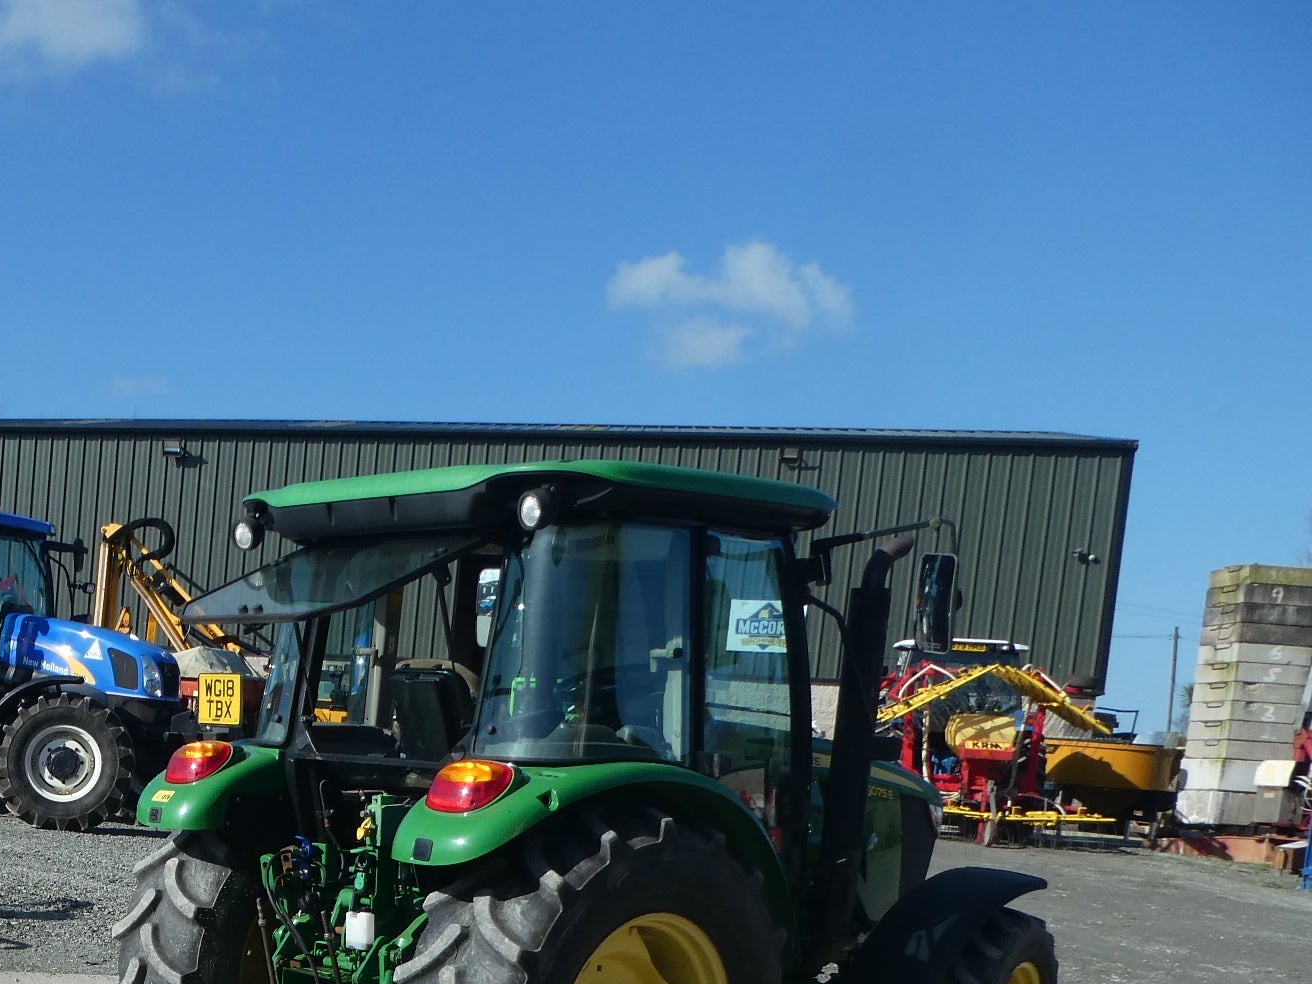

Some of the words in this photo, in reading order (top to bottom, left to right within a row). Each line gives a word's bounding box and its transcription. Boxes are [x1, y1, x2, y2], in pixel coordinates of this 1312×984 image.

[23, 656, 38, 667] New
[41, 661, 68, 675] Holland
[205, 679, 234, 697] WG18
[206, 699, 232, 718] TBX
